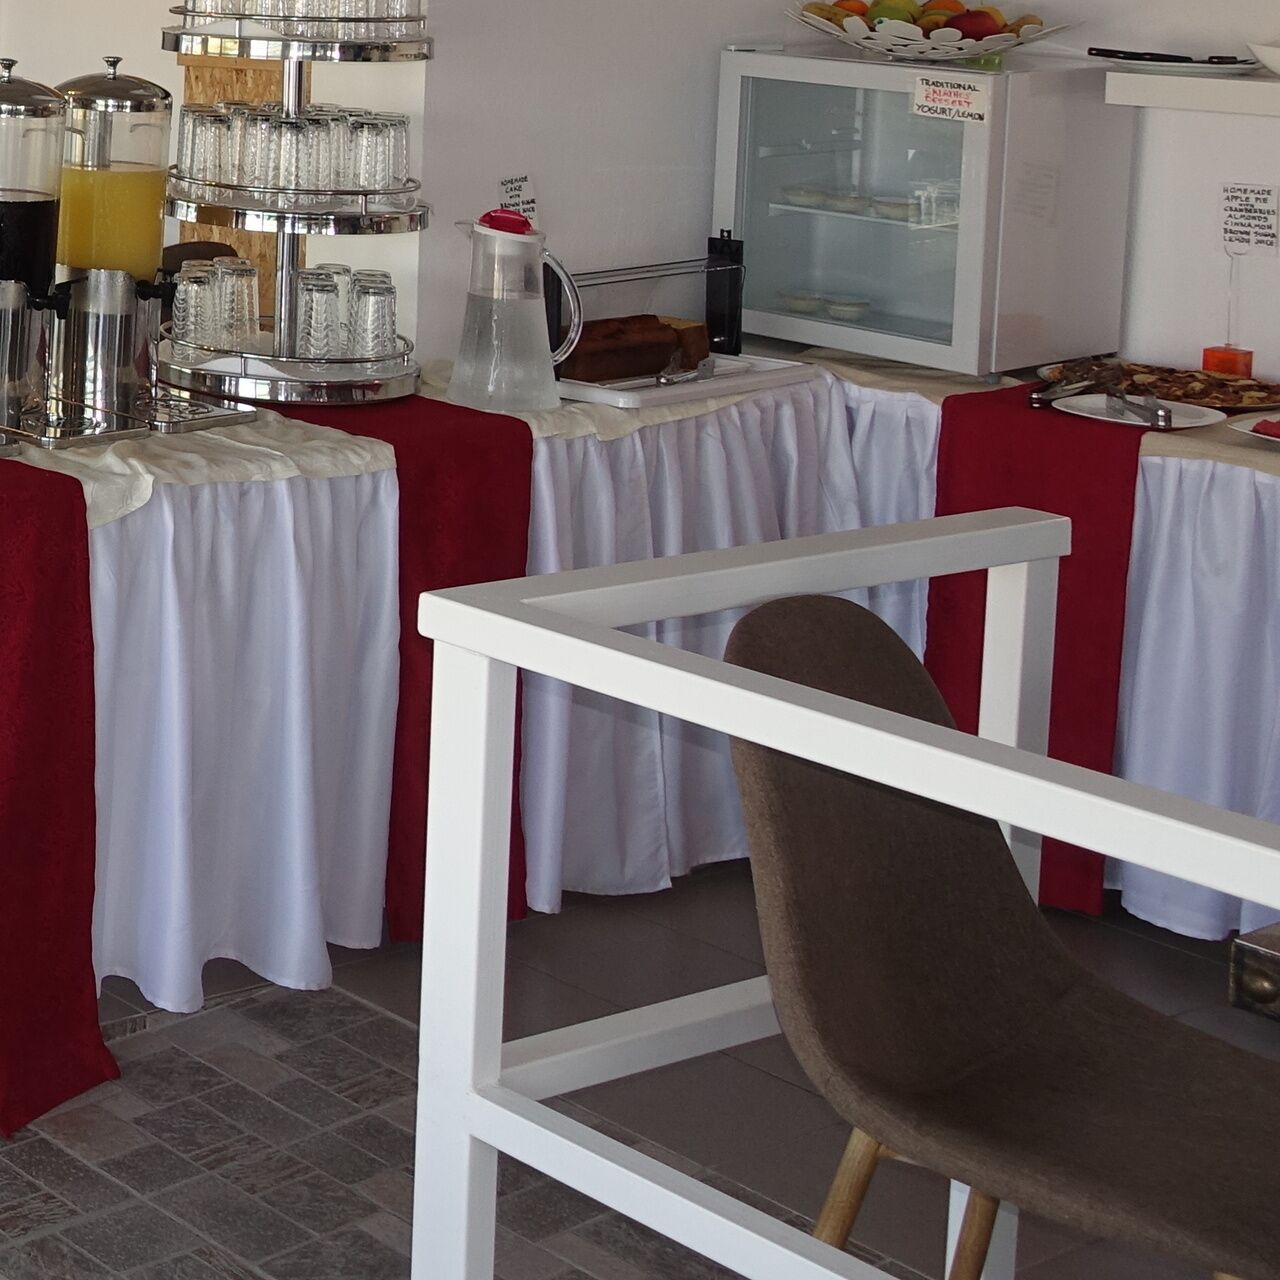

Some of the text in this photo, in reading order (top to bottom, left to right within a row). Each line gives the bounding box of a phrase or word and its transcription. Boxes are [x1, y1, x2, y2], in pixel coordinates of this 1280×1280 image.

[920, 78, 981, 92] TRADITIONAL
[925, 94, 972, 108] DESSERT
[915, 103, 985, 121] YOGURT/LEMON
[505, 184, 522, 193] CAKE
[1224, 206, 1276, 215] CRANBERRIES
[1227, 213, 1269, 223] ALMONDS
[1224, 220, 1272, 230] CINNAMON
[1223, 227, 1250, 236] BROWN
[1224, 235, 1274, 246] LEMON JUICE
